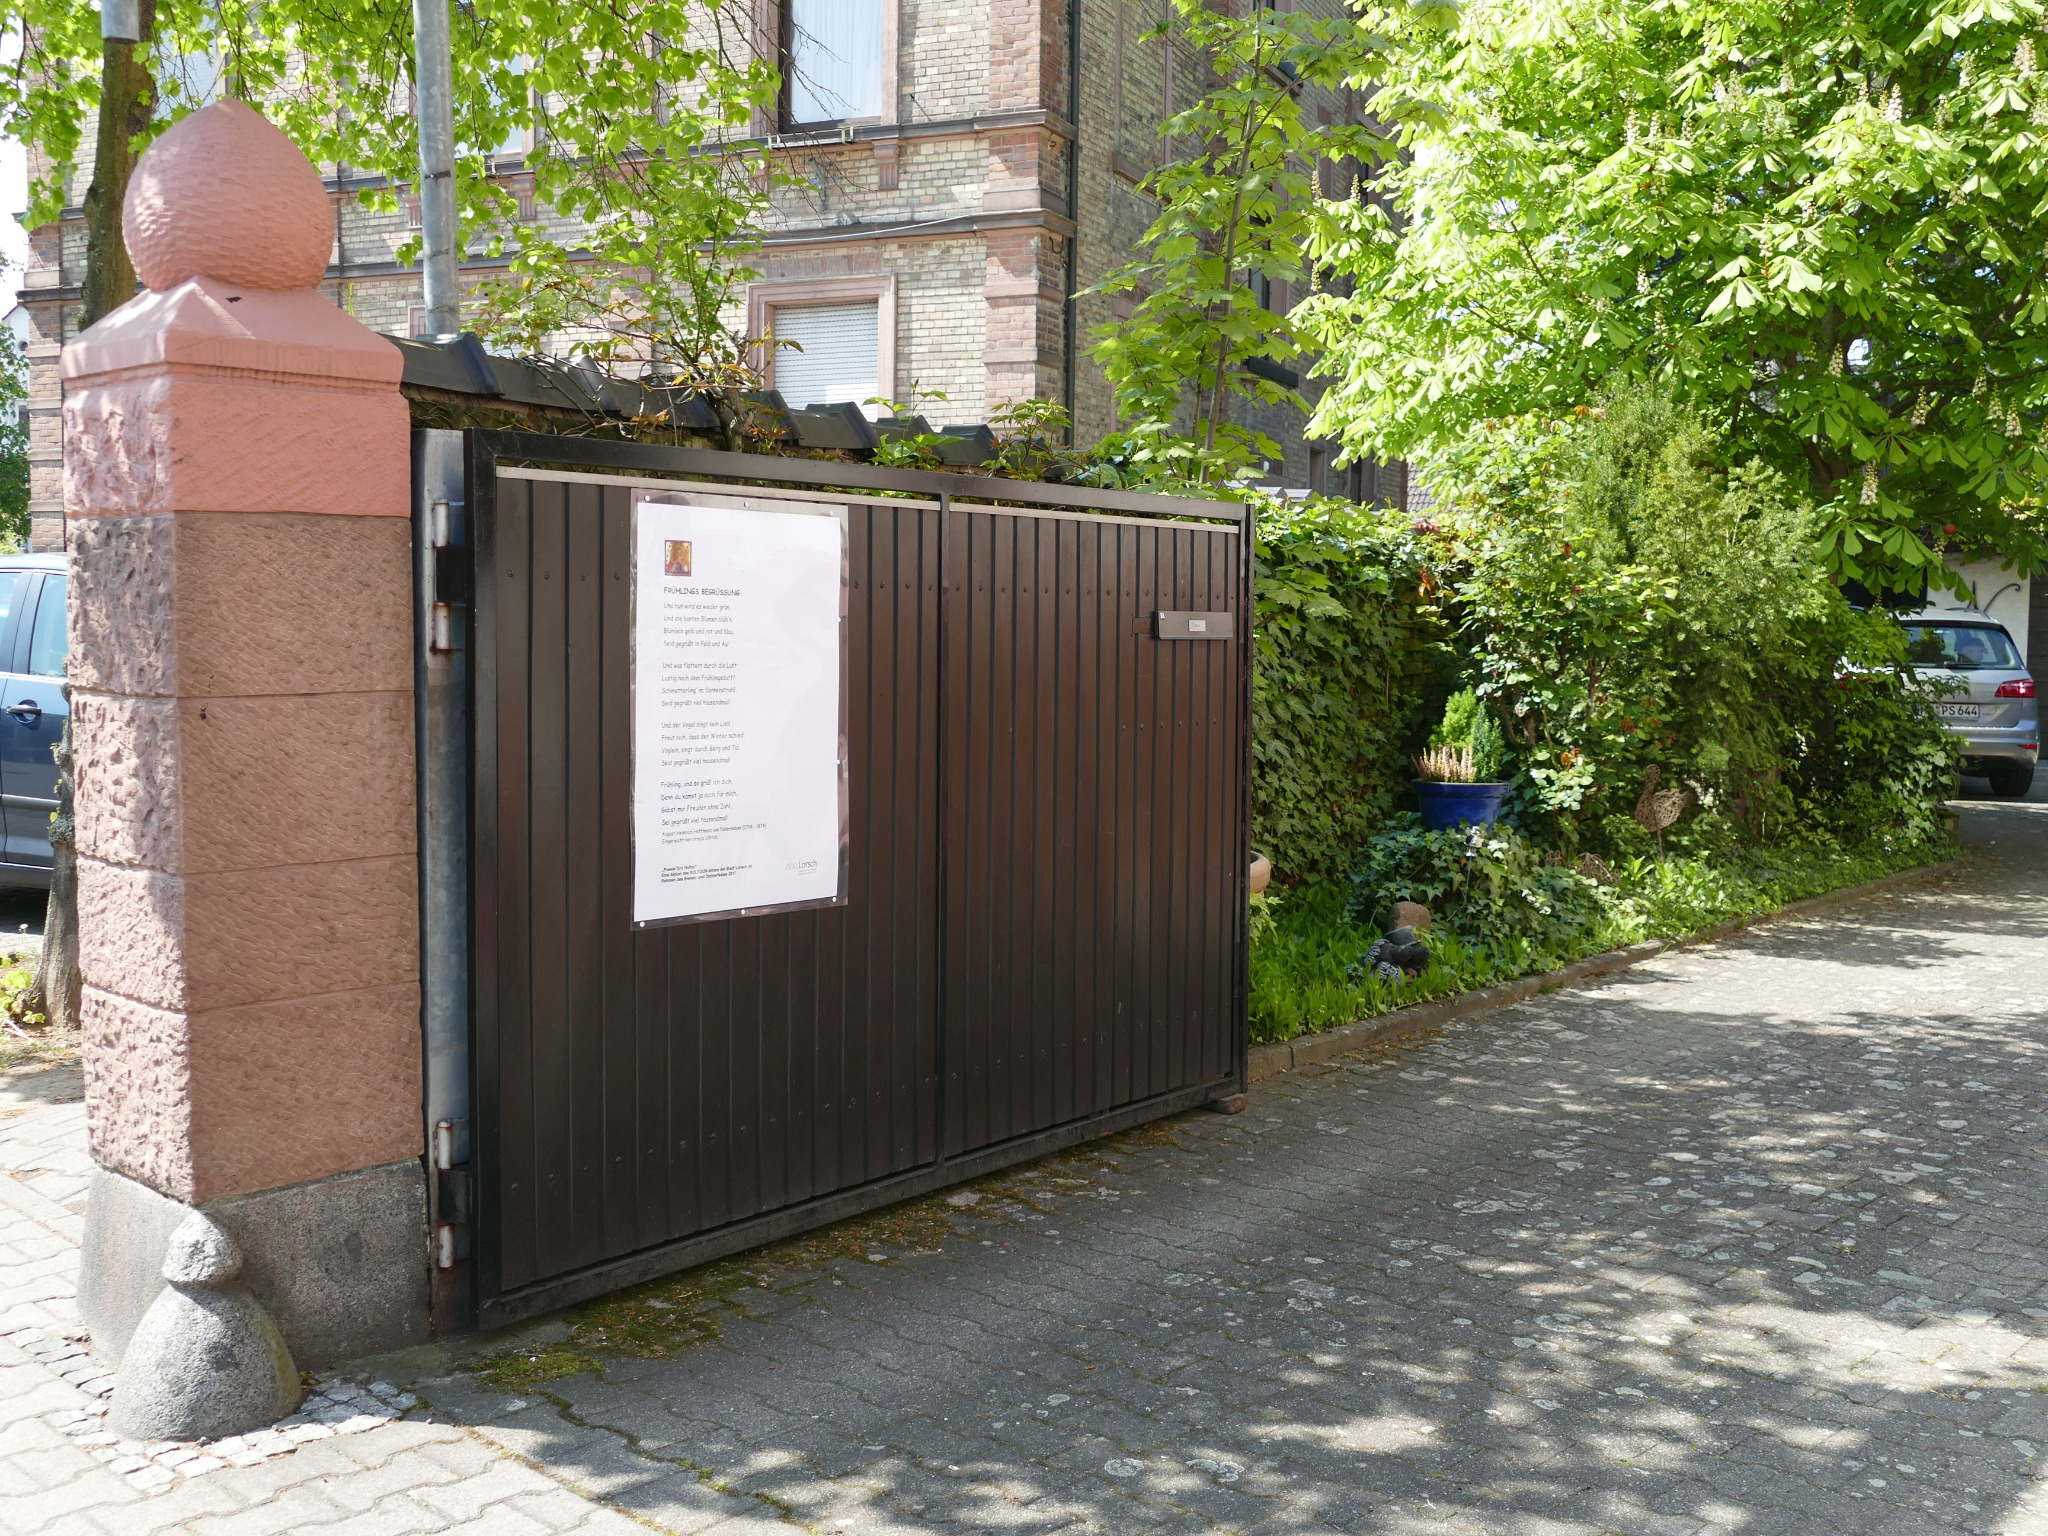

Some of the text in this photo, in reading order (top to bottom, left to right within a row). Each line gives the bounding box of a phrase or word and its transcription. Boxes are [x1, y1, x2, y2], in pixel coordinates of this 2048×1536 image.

[664, 586, 740, 596] FRÜHLINGS BEGRÜSSUNG
[1942, 703, 1955, 715] PS
[1958, 704, 1977, 715] 644
[682, 721, 695, 729] Vogel
[696, 721, 708, 729] singt
[698, 792, 703, 800] ja
[799, 859, 817, 868] Lorsch
